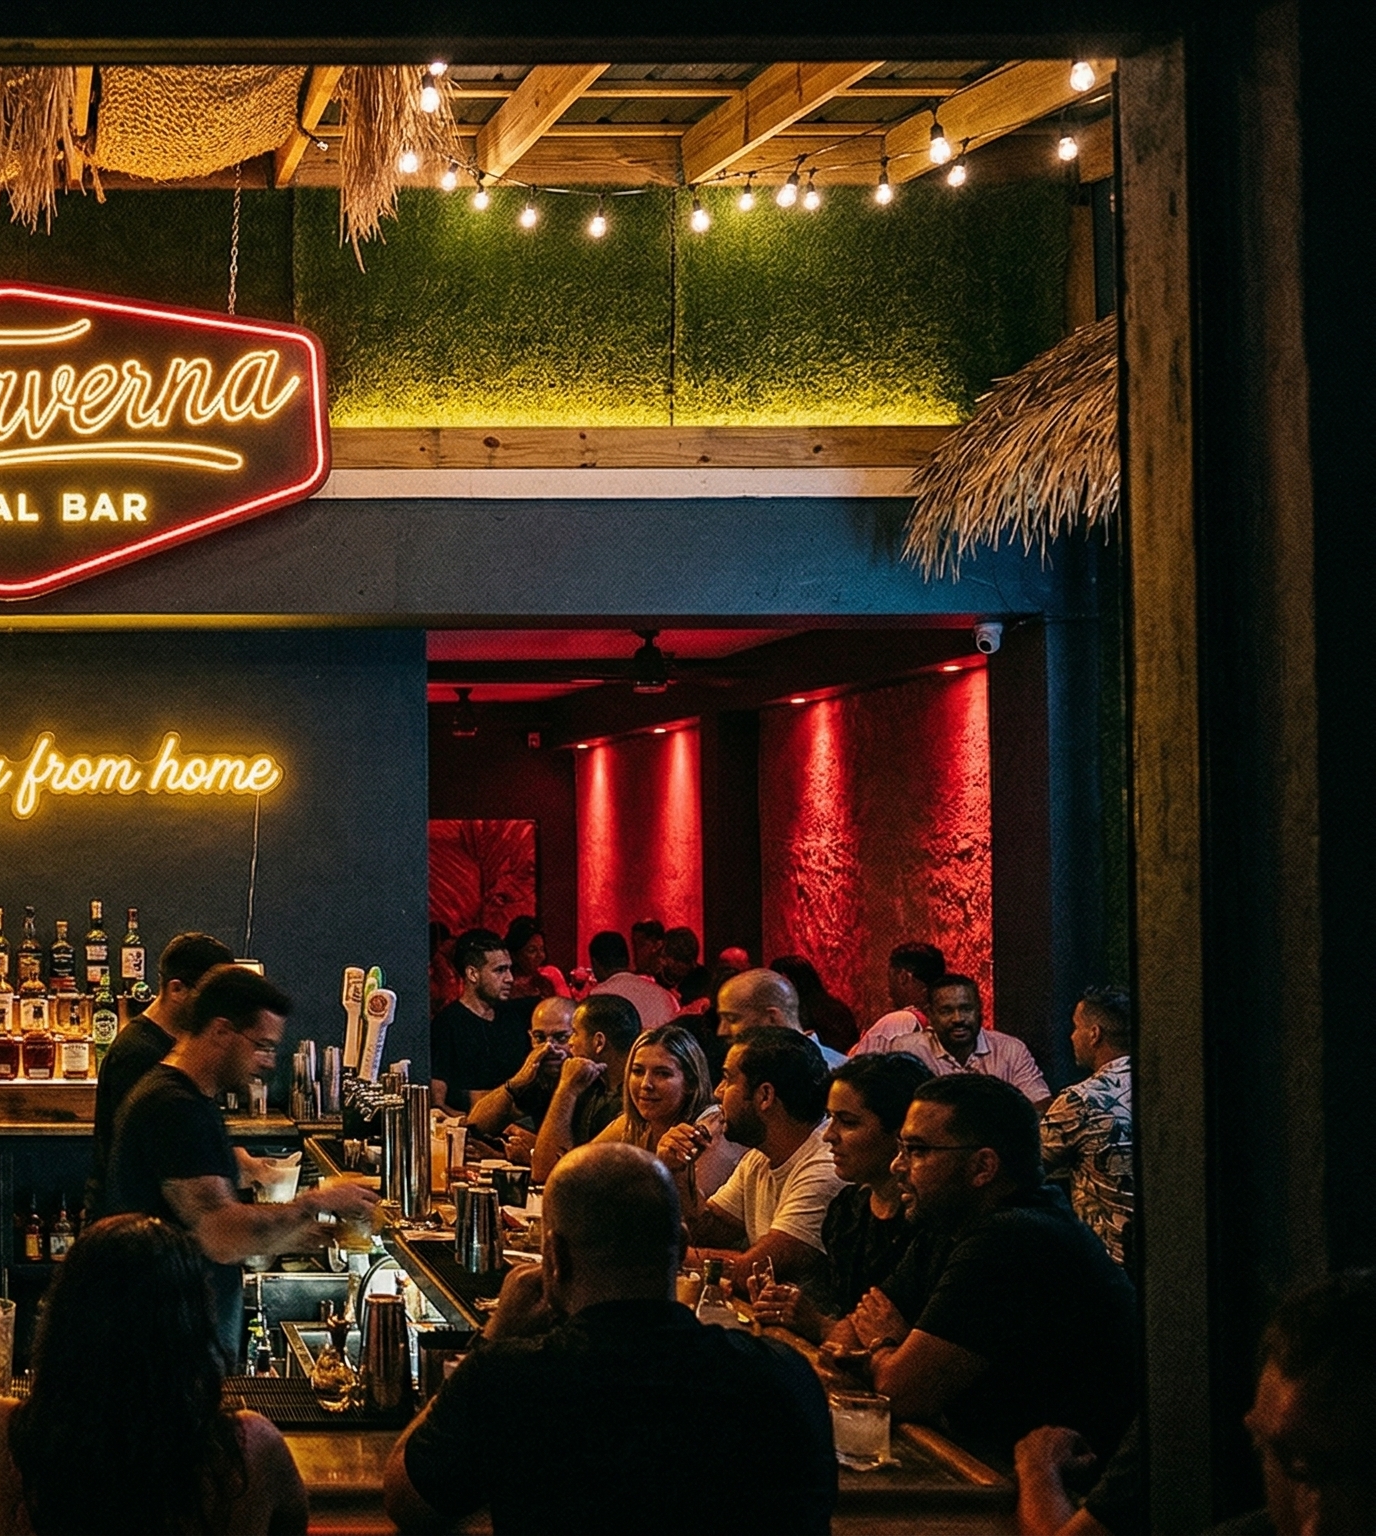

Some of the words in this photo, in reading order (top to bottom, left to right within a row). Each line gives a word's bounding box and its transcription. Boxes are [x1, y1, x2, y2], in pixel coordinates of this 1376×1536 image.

[62, 492, 147, 521] BAR
[15, 737, 142, 816] from
[149, 737, 281, 793] home
